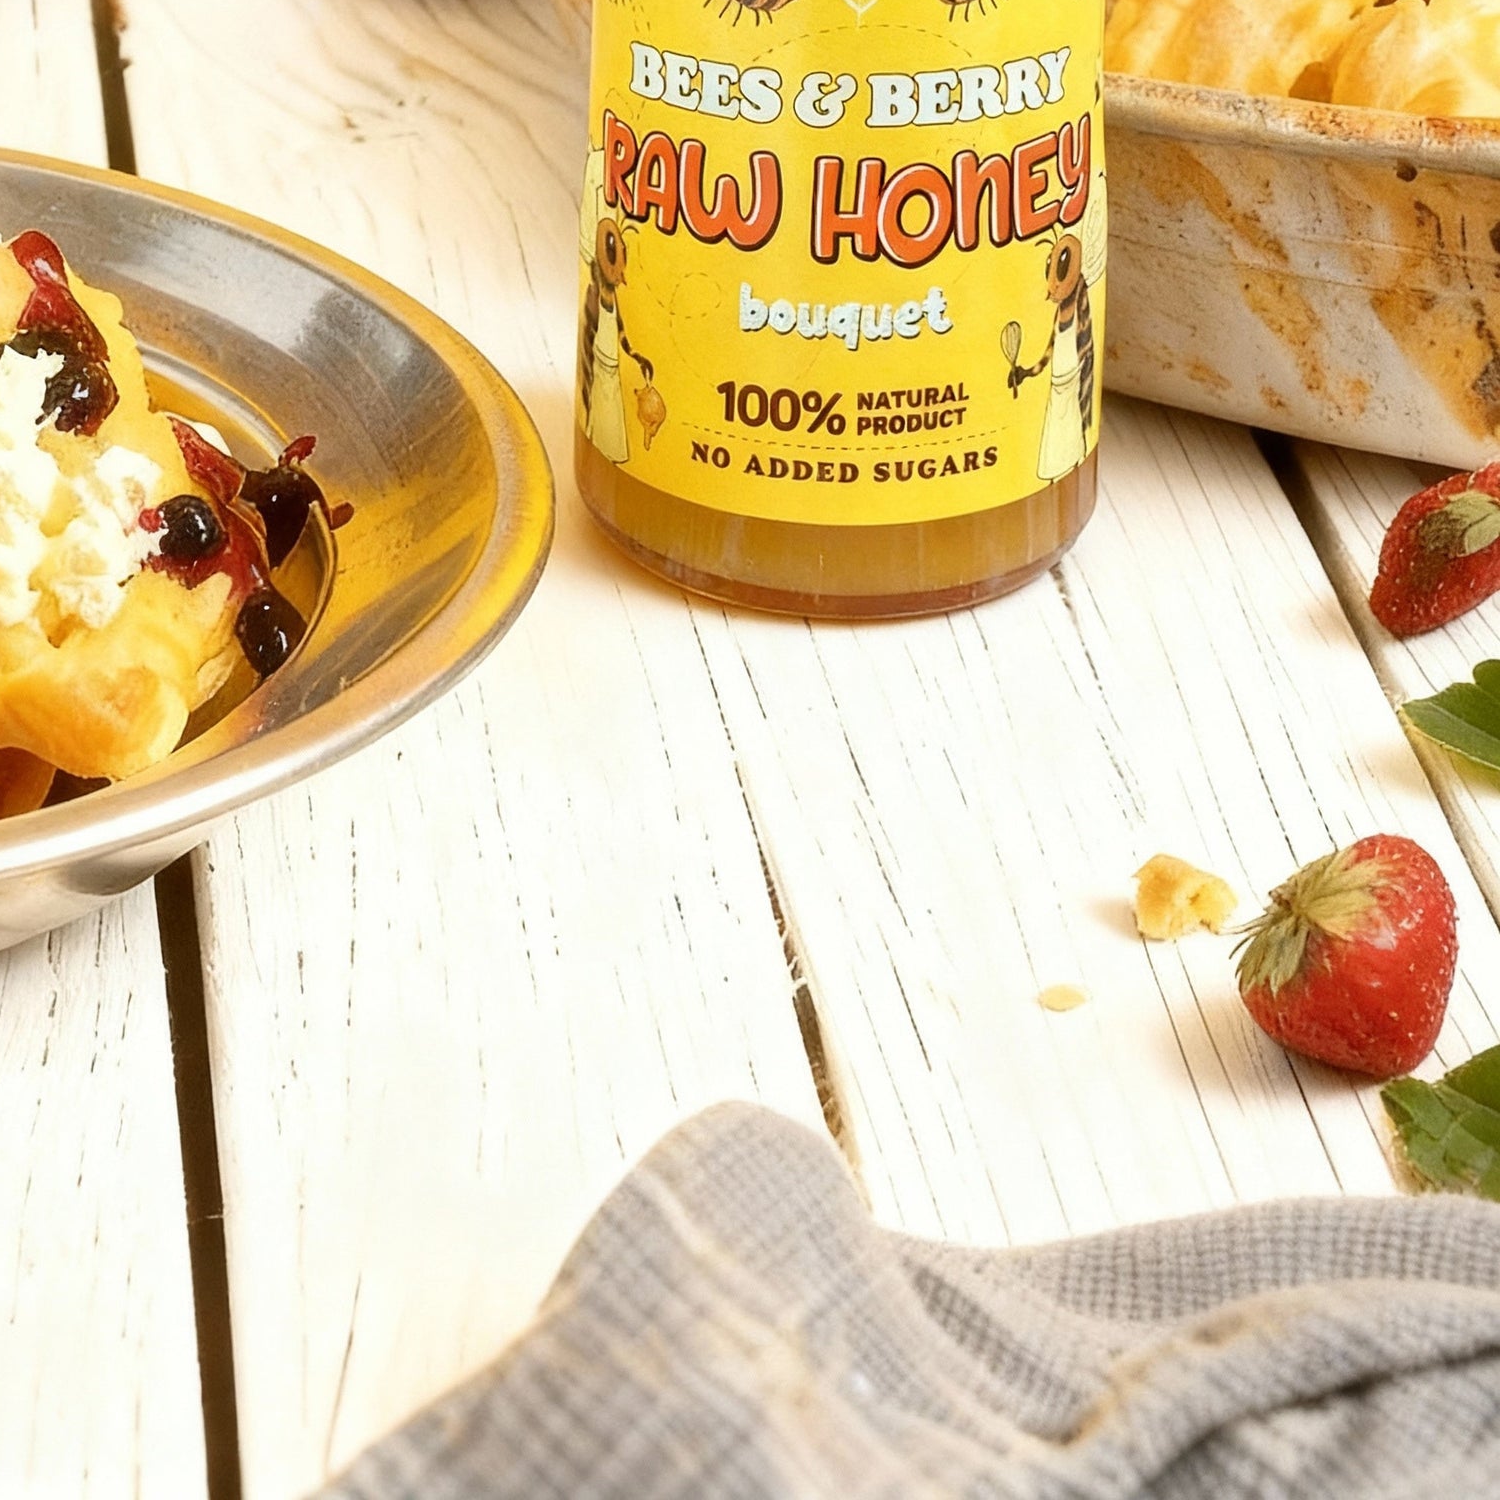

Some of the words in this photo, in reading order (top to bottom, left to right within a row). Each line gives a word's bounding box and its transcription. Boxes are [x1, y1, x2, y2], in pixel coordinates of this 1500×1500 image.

[630, 42, 783, 124] BEES
[794, 72, 857, 128] &
[866, 47, 1071, 128] BERRY
[603, 110, 782, 251] RAW
[739, 284, 953, 351] bouquet
[717, 381, 846, 435] 100%
[856, 383, 970, 411] NATURAL
[856, 407, 965, 436] PRODUCT
[691, 442, 731, 469] NO
[744, 455, 859, 484] ADDED
[873, 447, 998, 483] SUGARS
